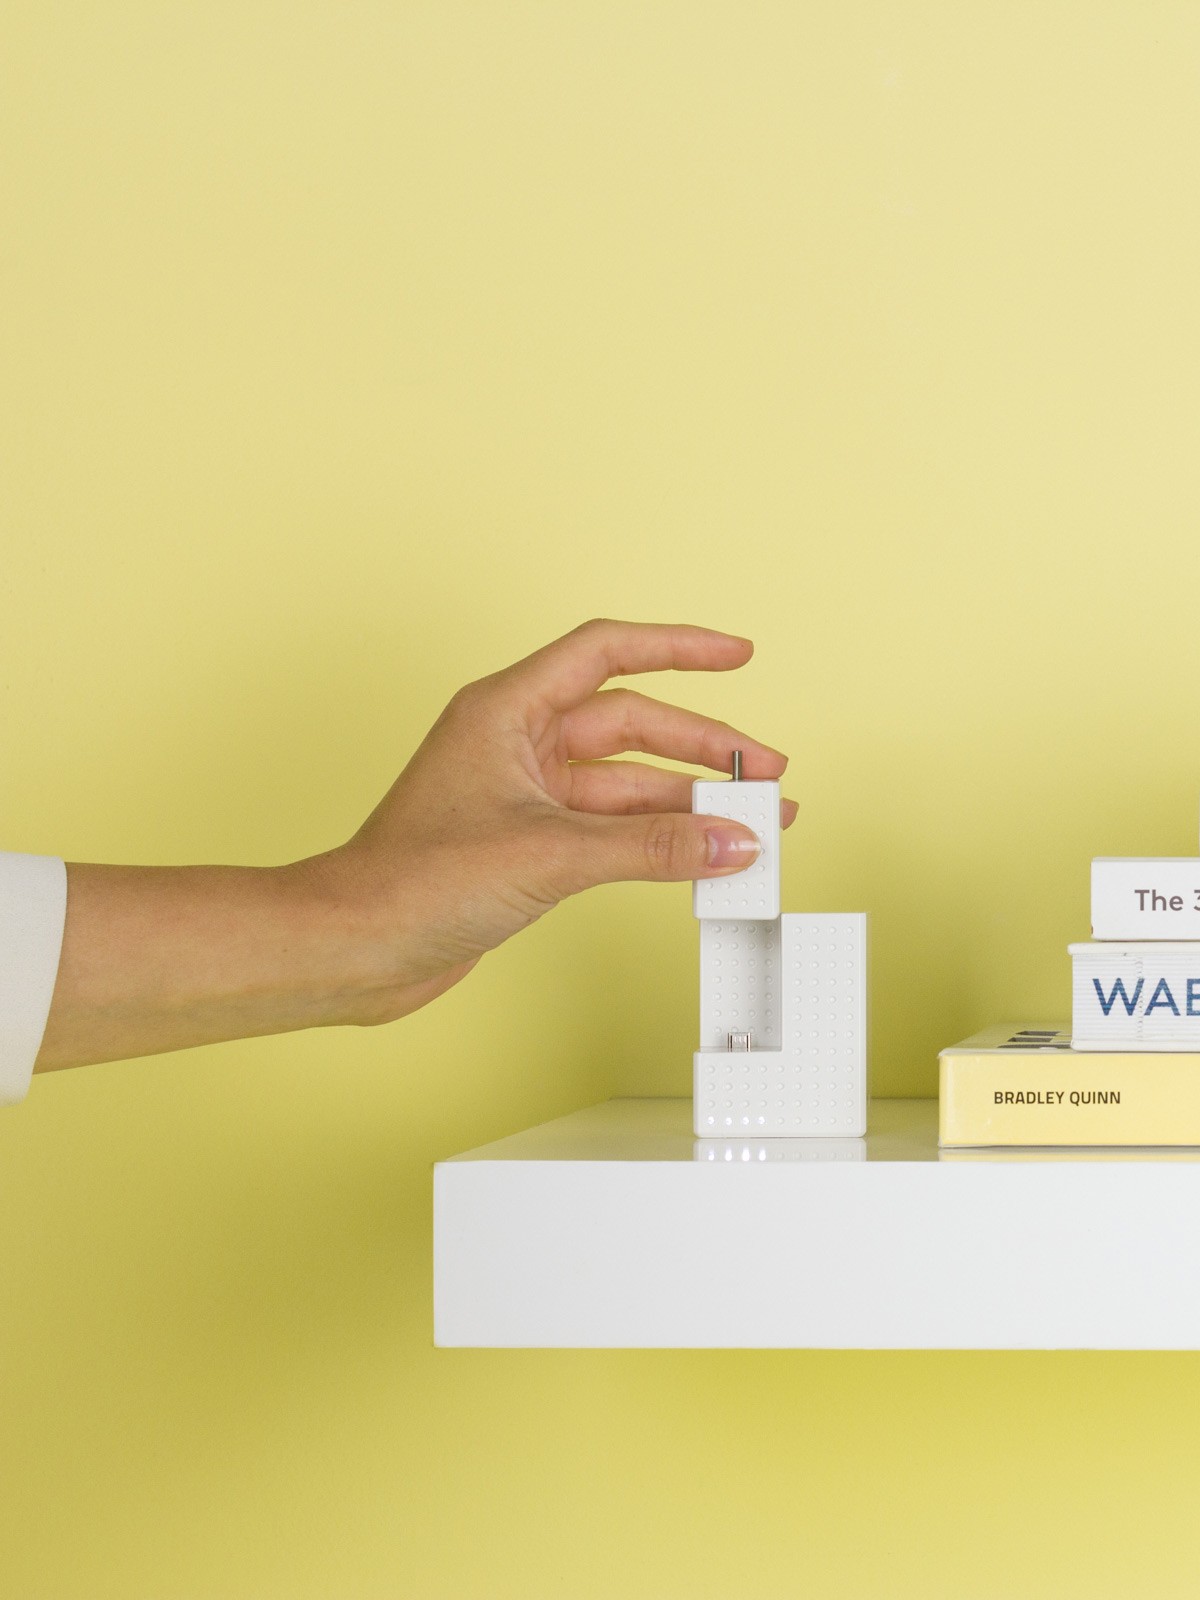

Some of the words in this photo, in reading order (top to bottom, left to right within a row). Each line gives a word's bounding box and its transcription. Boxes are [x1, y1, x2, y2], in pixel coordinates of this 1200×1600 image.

[1134, 889, 1184, 912] The
[993, 1091, 1065, 1105] BRADLEY
[1069, 1091, 1121, 1107] QUINN
